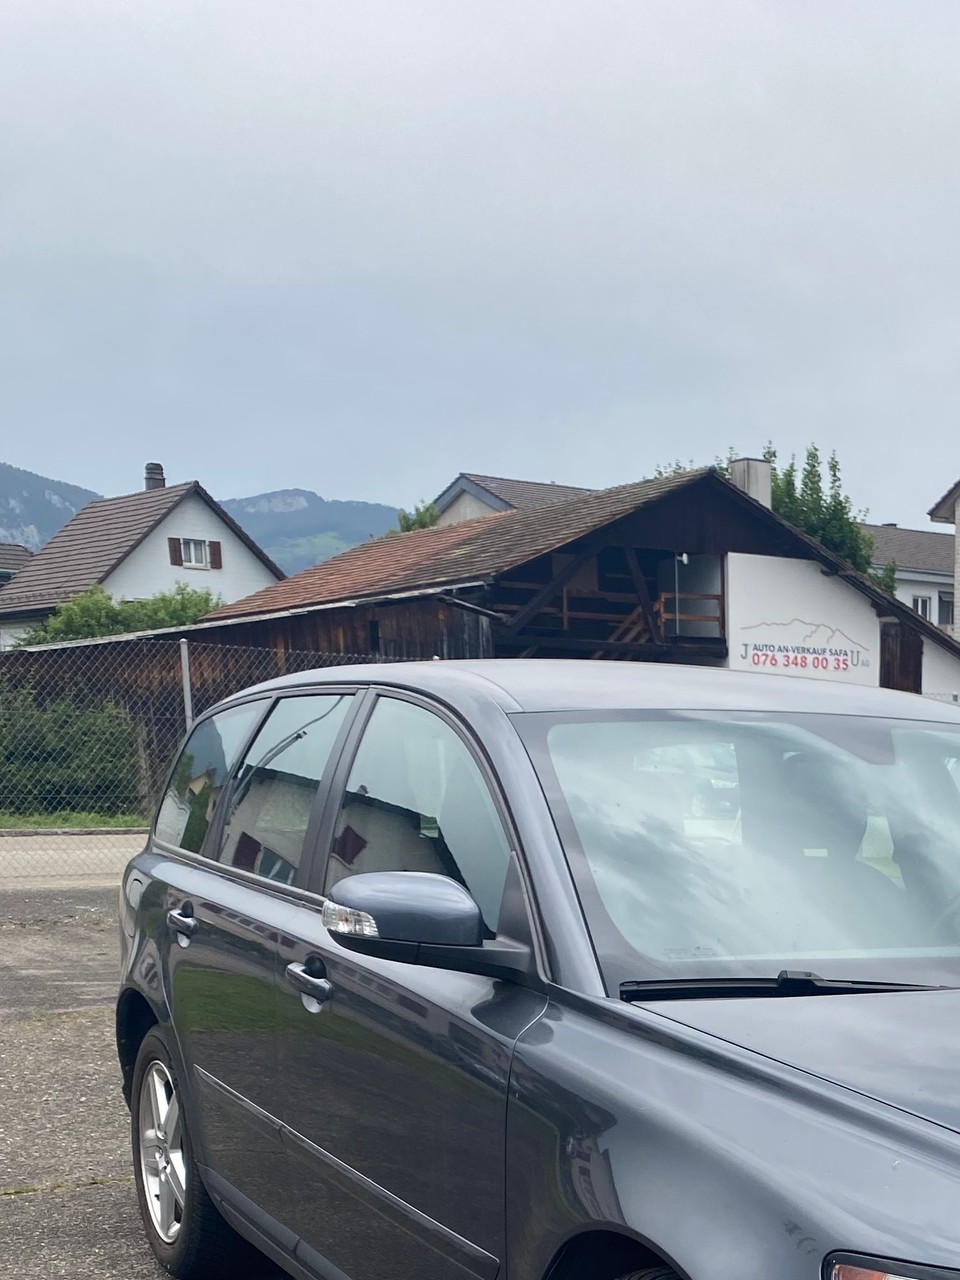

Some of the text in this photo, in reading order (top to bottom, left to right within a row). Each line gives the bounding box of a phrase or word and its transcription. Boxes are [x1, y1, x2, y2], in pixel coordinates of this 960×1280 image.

[752, 643, 849, 657] AUTO AN-VERKAUF SAFA
[752, 653, 849, 671] 076 348 00 35
